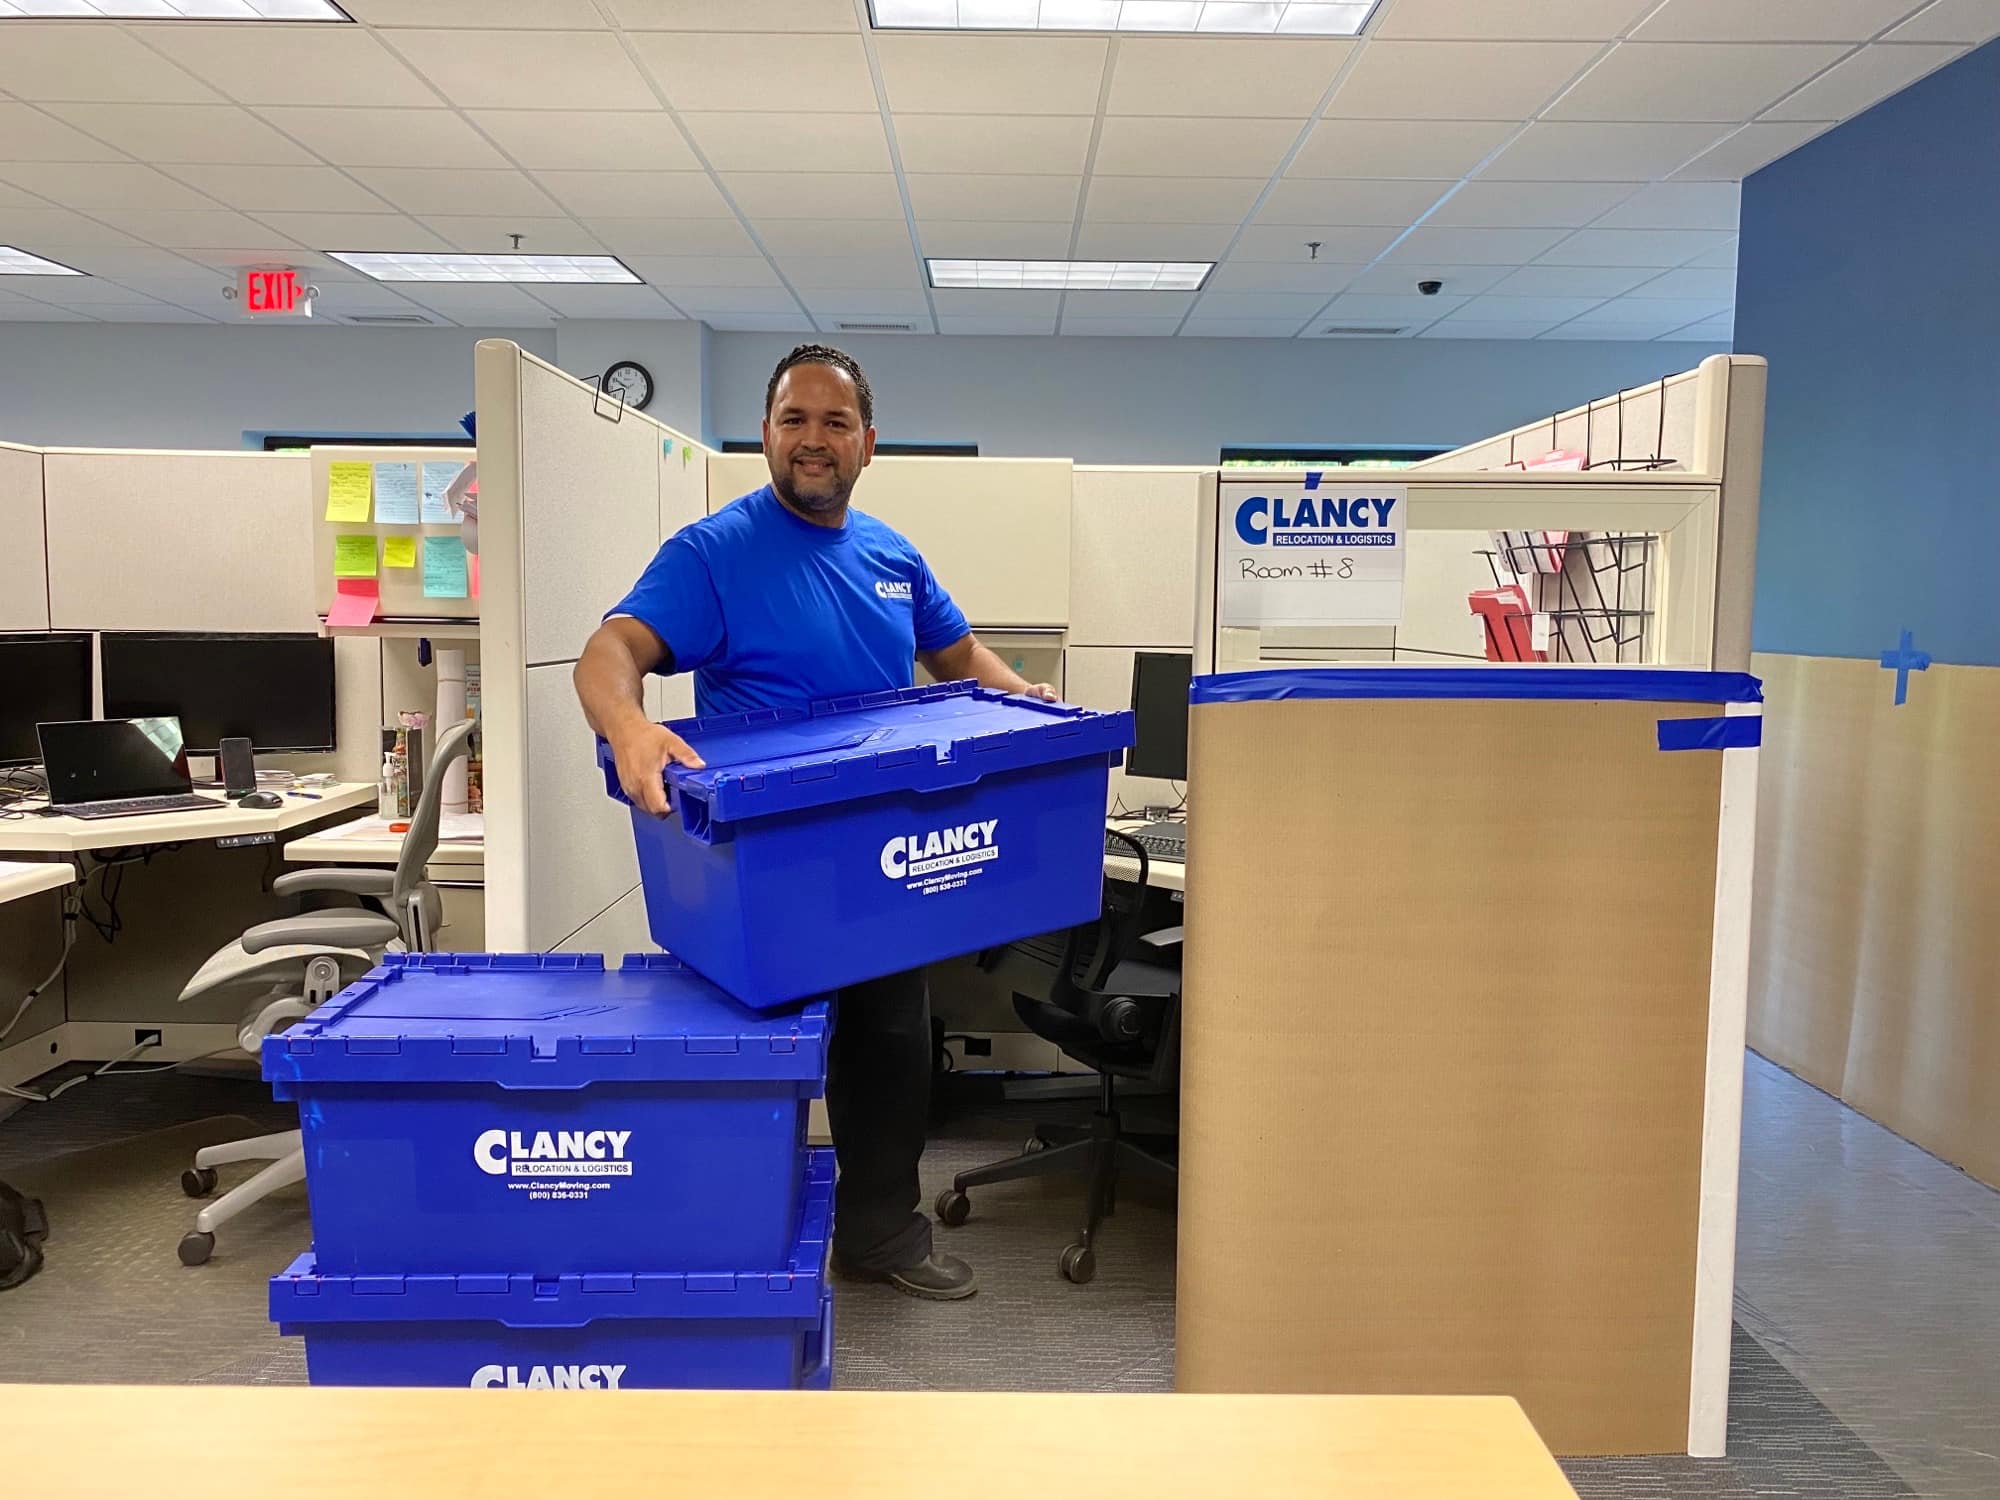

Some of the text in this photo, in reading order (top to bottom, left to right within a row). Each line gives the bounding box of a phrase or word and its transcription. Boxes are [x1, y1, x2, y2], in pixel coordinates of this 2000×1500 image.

[248, 271, 296, 312] EXIT
[1235, 496, 1397, 545] CLANCY
[1276, 535, 1393, 545] RELOCATION & LOGISTICS
[1239, 557, 1354, 579] Room #8
[875, 581, 912, 599] CLANCY
[880, 819, 998, 879] CLANCY
[912, 857, 954, 873] RELOCATION
[962, 849, 996, 863] LOGISTICS
[474, 1129, 632, 1175] CLANCY
[515, 1164, 629, 1173] RELOCATION & LOGISTICS
[508, 1181, 611, 1192] www.ClancyMoving.com
[529, 1191, 550, 1200] (800)
[470, 1365, 627, 1389] CLANCY
